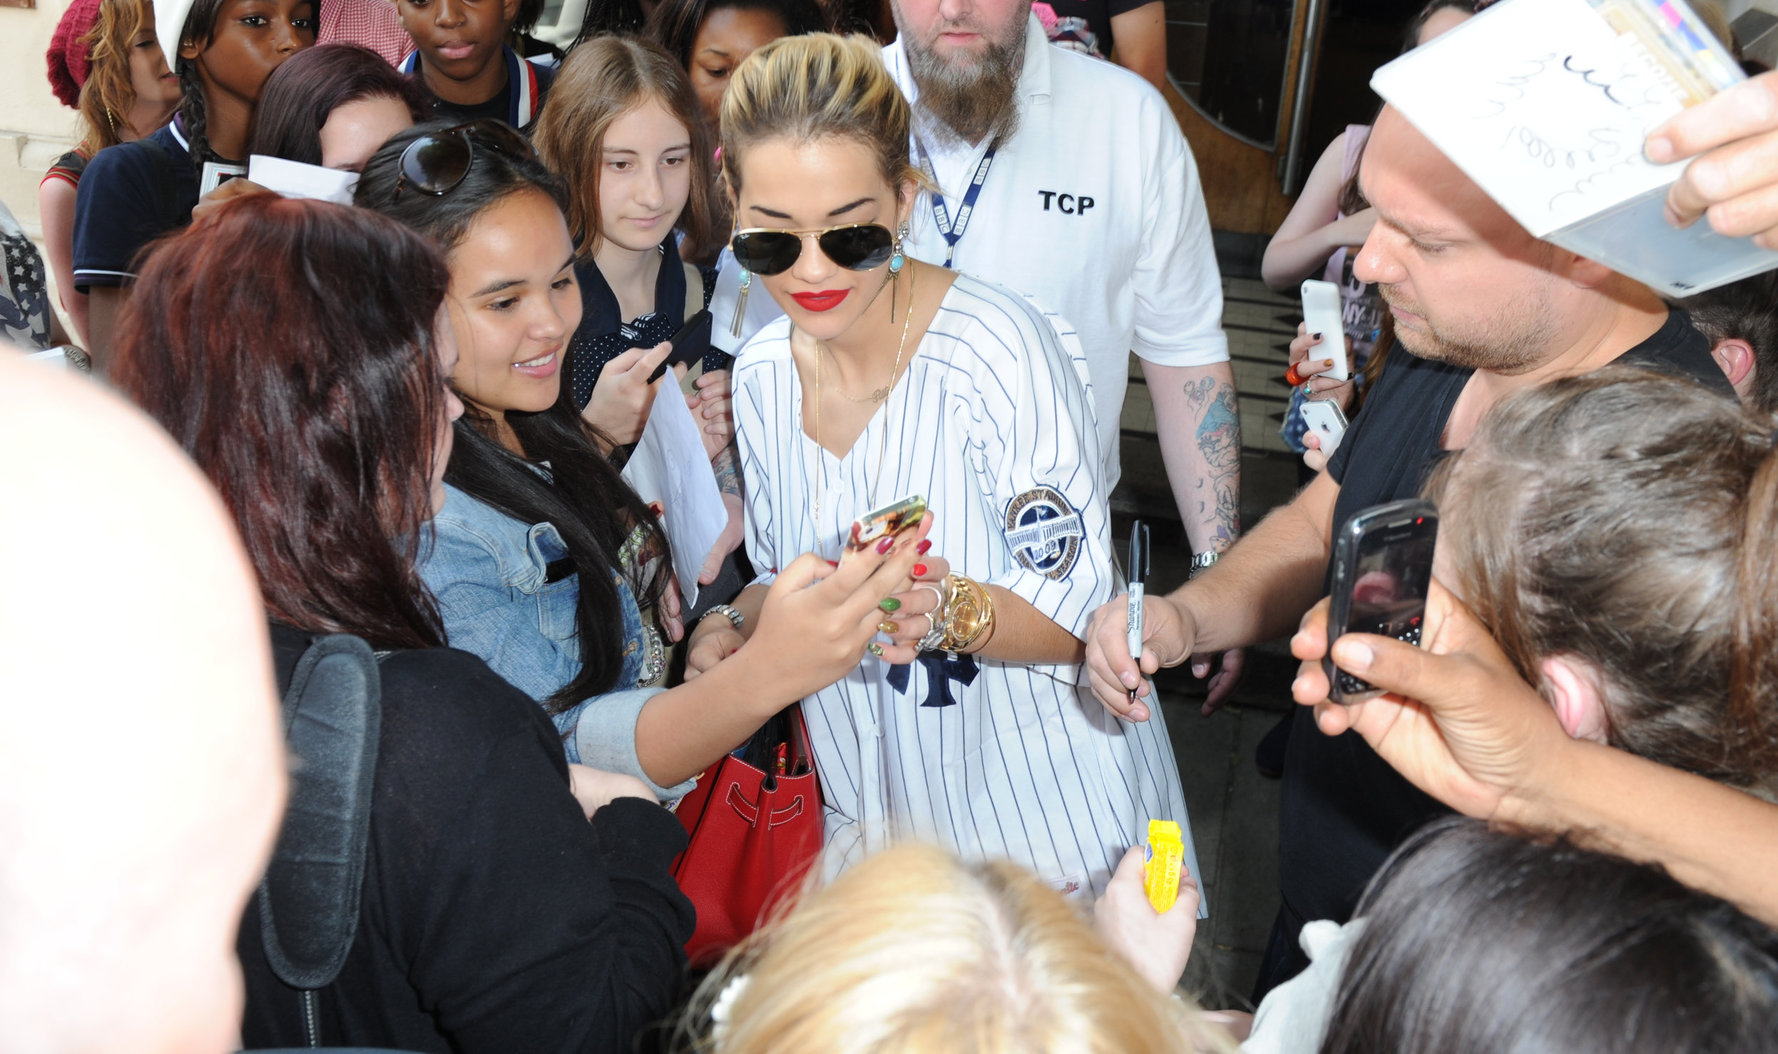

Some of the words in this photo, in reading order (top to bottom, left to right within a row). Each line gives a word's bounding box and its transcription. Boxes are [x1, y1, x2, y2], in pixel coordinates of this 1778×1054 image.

[1038, 190, 1095, 216] TCP
[934, 204, 951, 235] BBC
[953, 204, 972, 236] BBC
[1034, 540, 1056, 560] 2009
